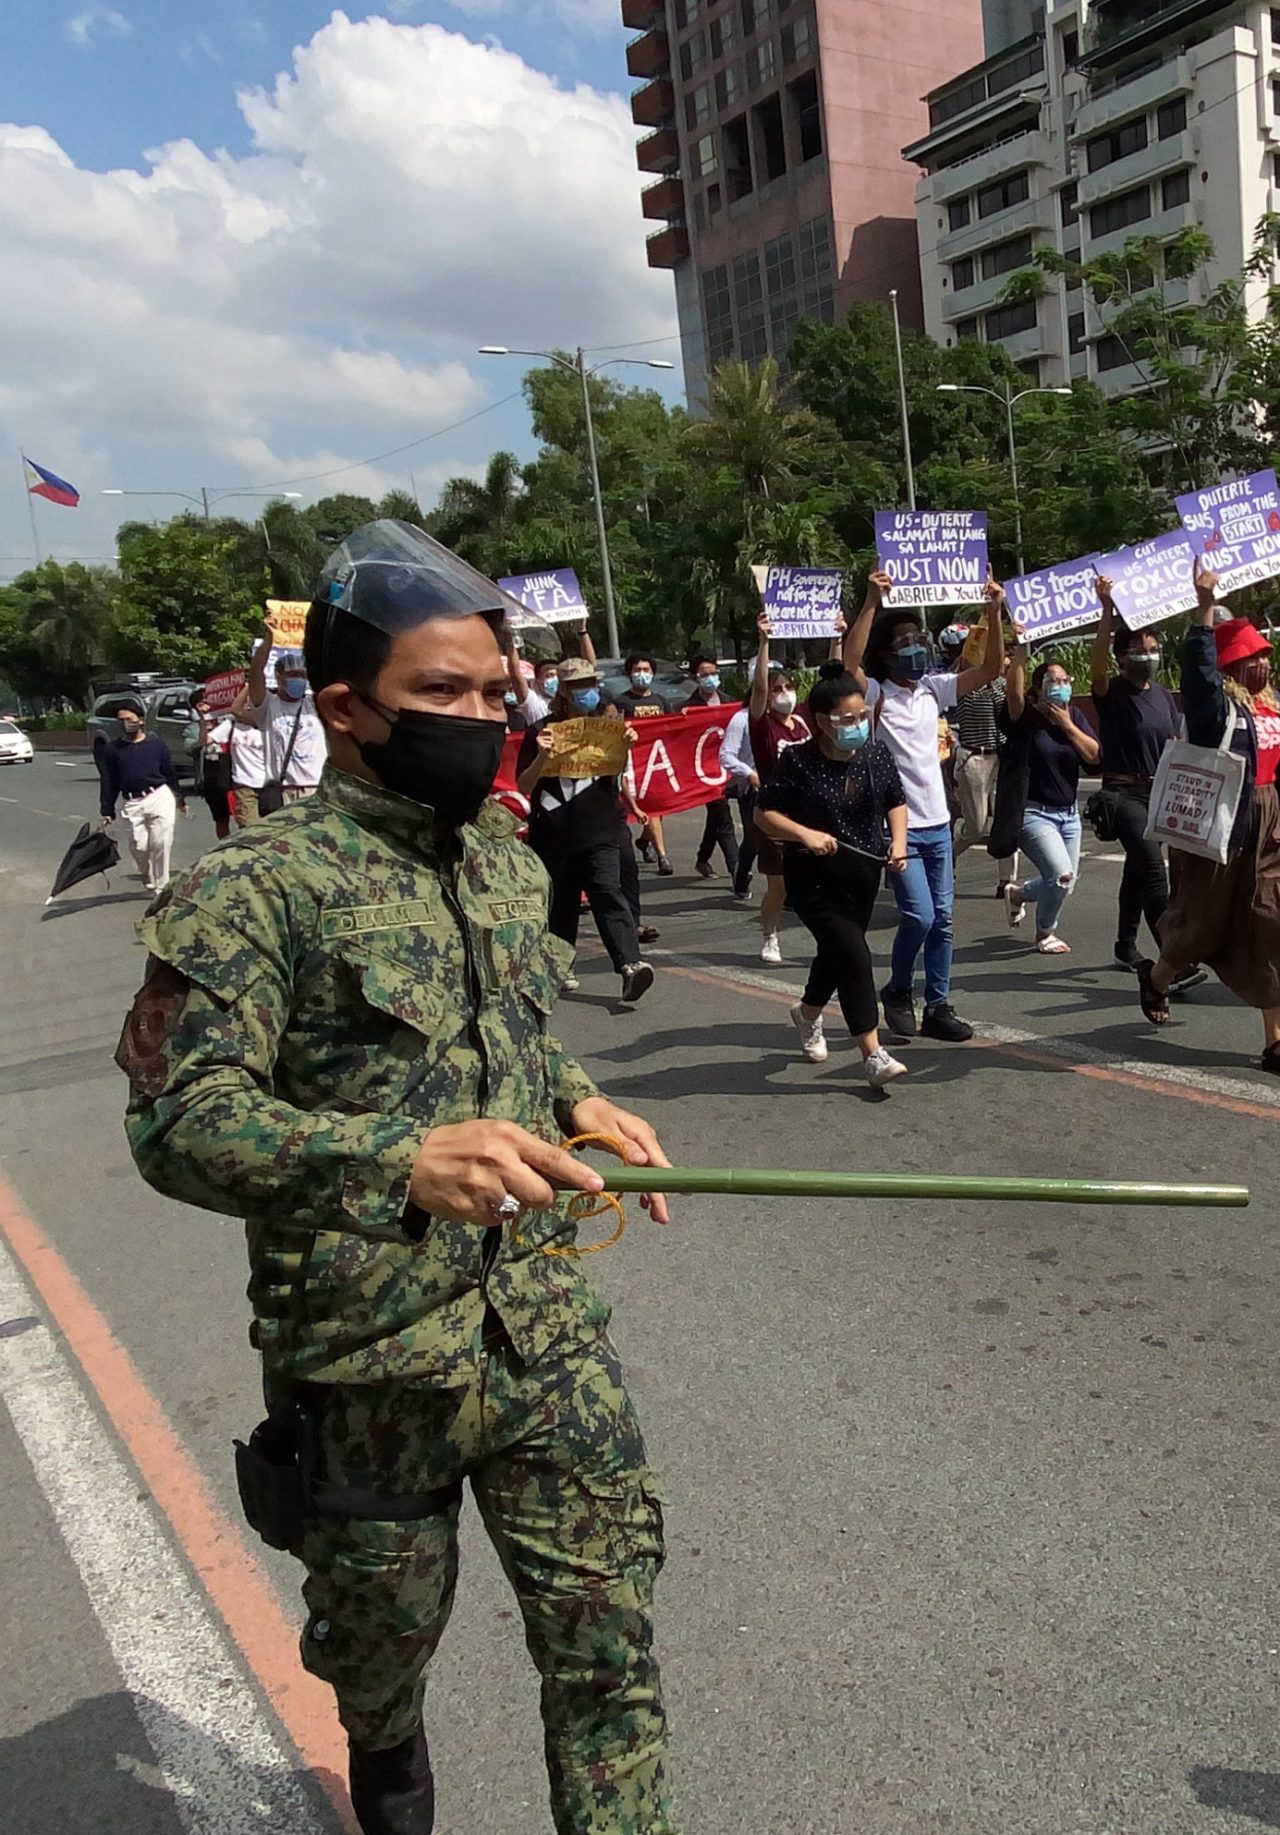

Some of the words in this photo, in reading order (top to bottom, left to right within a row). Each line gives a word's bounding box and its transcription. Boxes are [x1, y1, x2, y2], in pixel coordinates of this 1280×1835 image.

[1198, 479, 1253, 512] DUTERTE
[1219, 502, 1252, 523] FROM
[1252, 491, 1278, 511] THE
[894, 513, 974, 529] US-DUTERTE
[1224, 517, 1262, 540] START
[881, 528, 937, 541] SALAMAT
[898, 542, 914, 554] SA
[1134, 542, 1157, 559] CUT
[1201, 544, 1243, 571] OUST
[768, 568, 792, 588] PH
[885, 557, 932, 582] OUST
[937, 557, 979, 582] NOW
[1110, 558, 1191, 596] TOXIC
[523, 573, 563, 593] JUNK
[1014, 576, 1046, 603] US
[887, 586, 949, 605] GABRIELA
[280, 604, 305, 617] NO
[1014, 596, 1052, 624] OUT
